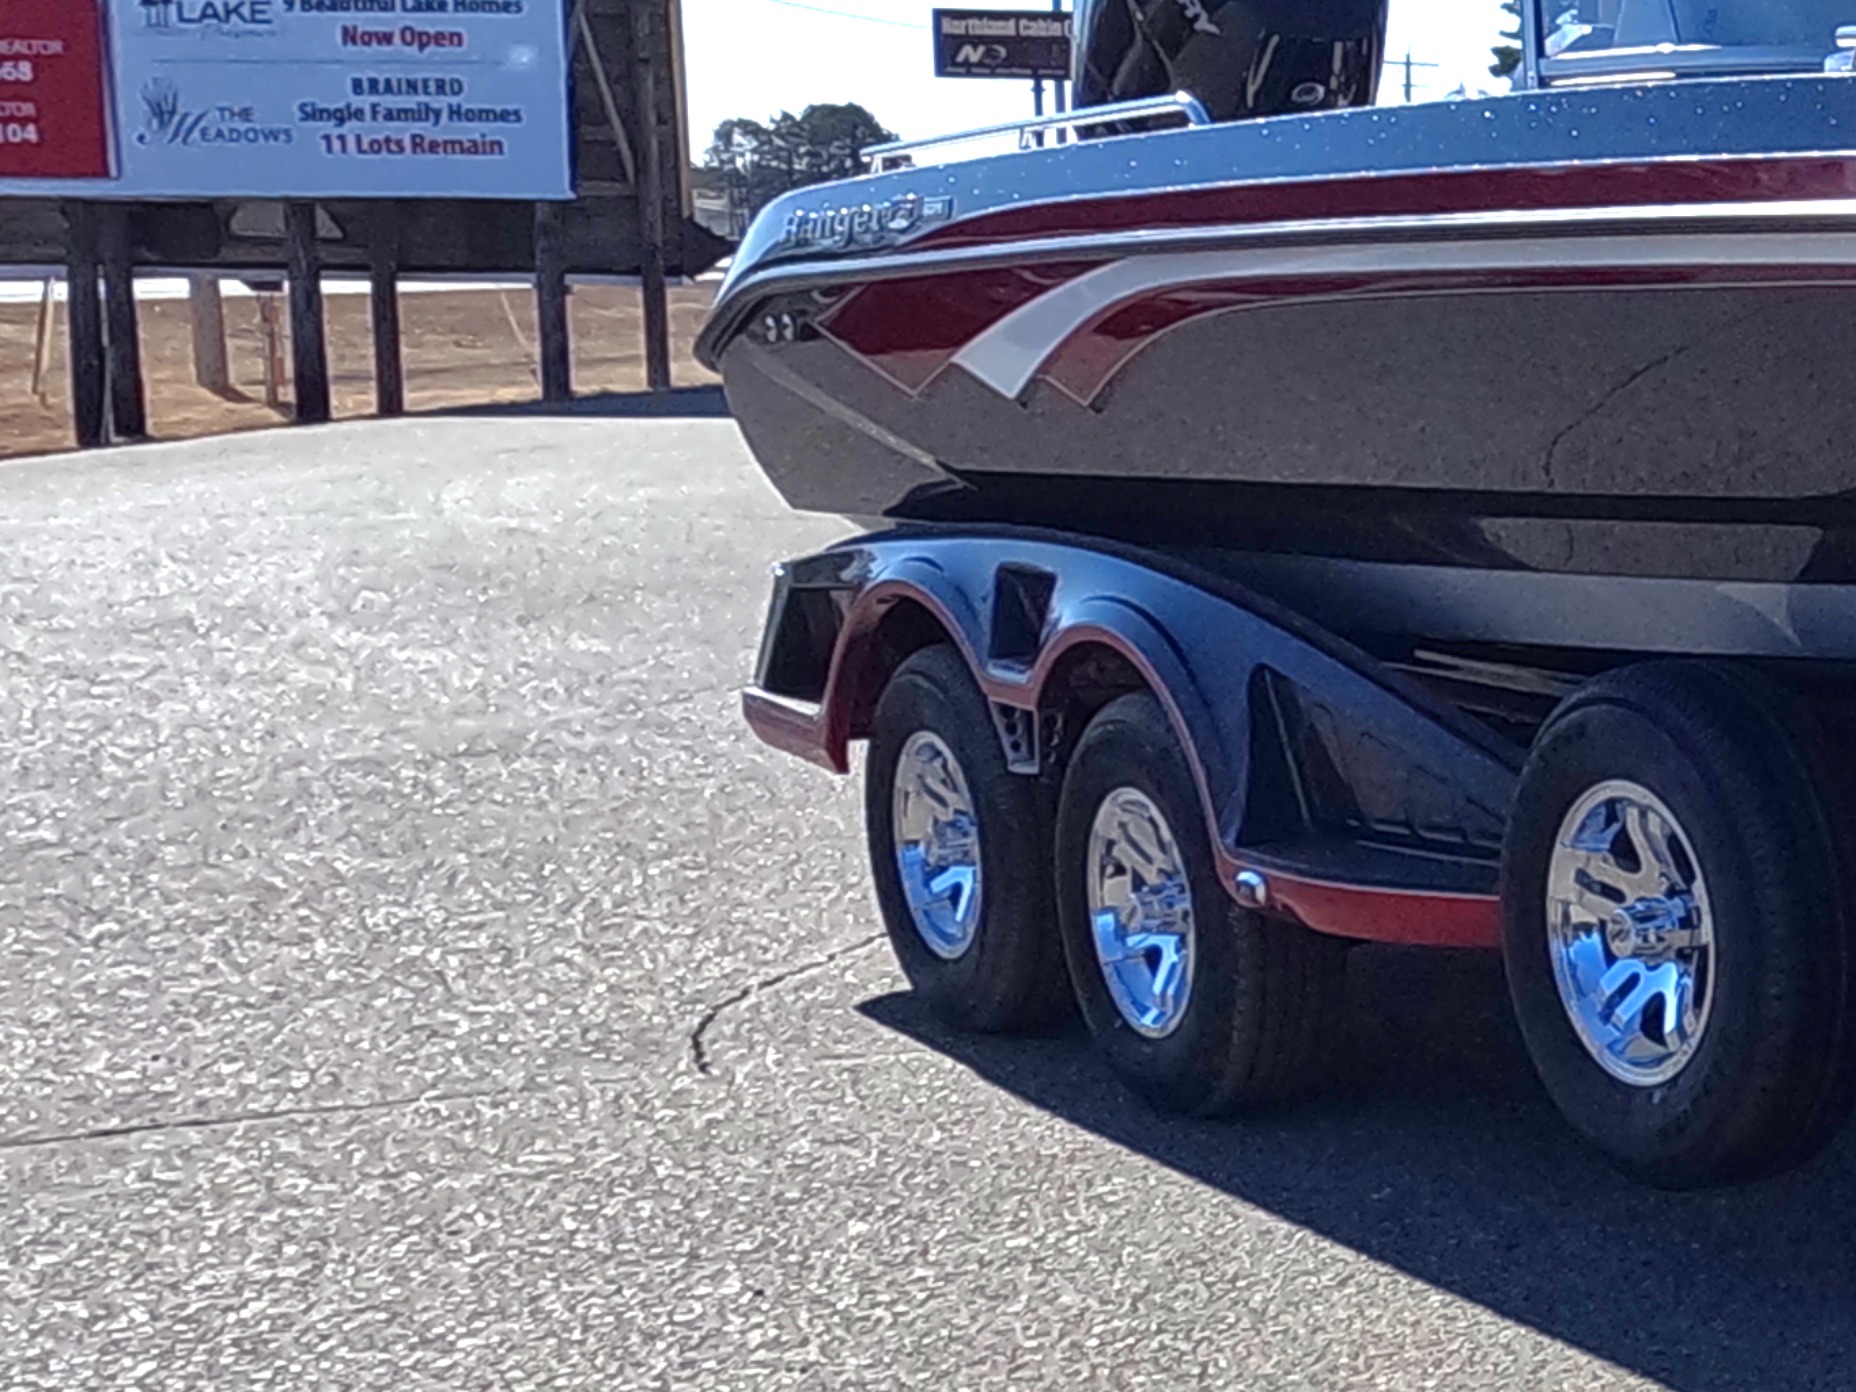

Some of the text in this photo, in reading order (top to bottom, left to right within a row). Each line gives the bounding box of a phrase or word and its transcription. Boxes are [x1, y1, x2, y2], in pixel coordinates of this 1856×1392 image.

[174, 0, 274, 25] LAKE
[340, 25, 464, 53] Now Open
[350, 77, 465, 97] BRAINERD
[215, 106, 256, 122] THE
[298, 102, 523, 127] Single Family Homes
[320, 134, 505, 157] 11 Lots Remain
